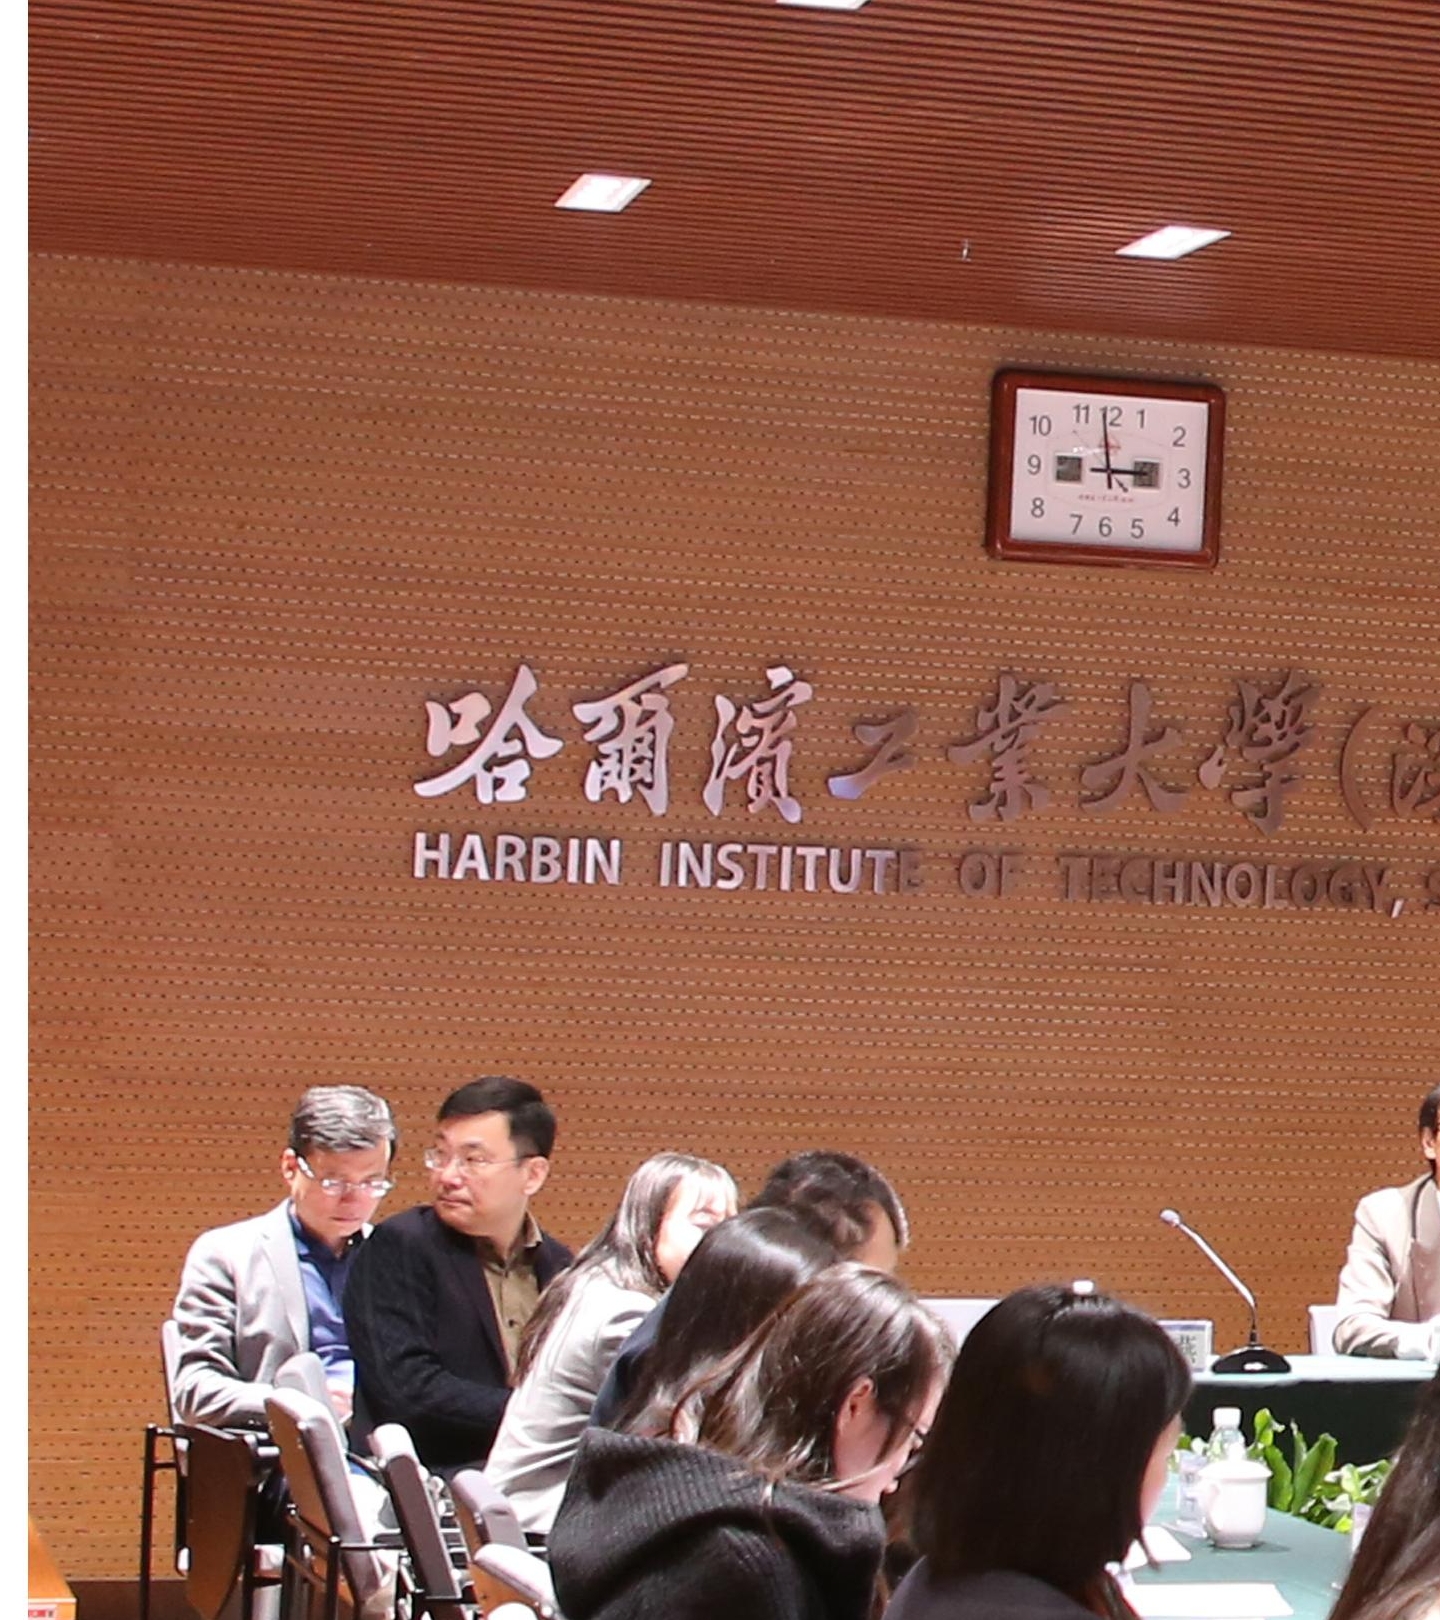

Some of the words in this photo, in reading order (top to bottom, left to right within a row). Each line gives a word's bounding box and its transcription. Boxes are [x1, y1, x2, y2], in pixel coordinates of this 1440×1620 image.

[1073, 404, 1090, 424] 11
[1101, 406, 1122, 427] 12
[1136, 409, 1145, 428] 1
[1029, 415, 1051, 436] 10
[1172, 426, 1187, 447] 2
[1027, 454, 1041, 475] 9
[1178, 468, 1191, 489] 3
[1031, 498, 1045, 518] 8
[1167, 507, 1180, 526] 4
[1069, 514, 1083, 535] 7
[1099, 517, 1112, 537] 6
[1131, 519, 1144, 538] 5
[413, 831, 620, 886] HARBIN
[660, 842, 919, 895] INSTITUTE
[959, 851, 1026, 897] OF
[1057, 856, 1404, 918] TECHNOLOGY,
